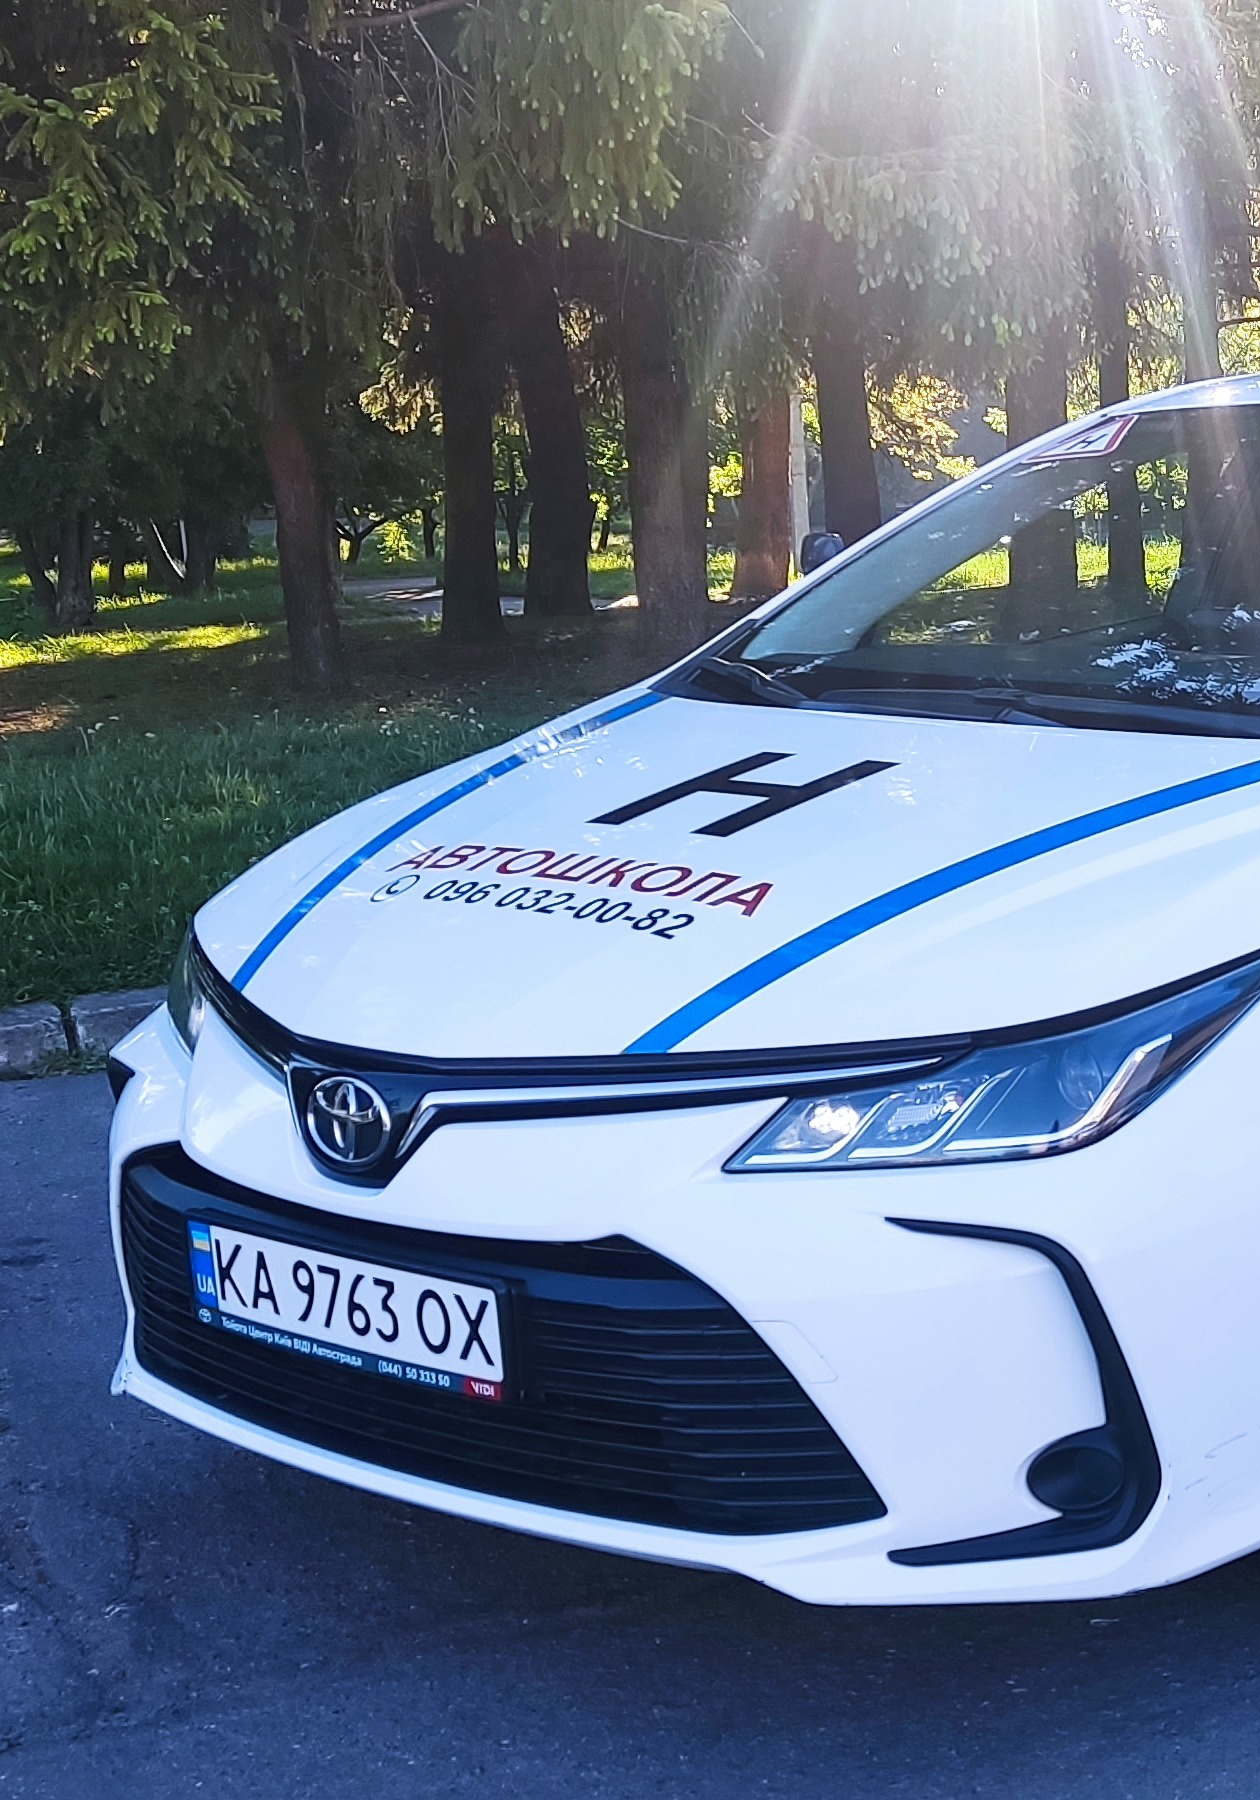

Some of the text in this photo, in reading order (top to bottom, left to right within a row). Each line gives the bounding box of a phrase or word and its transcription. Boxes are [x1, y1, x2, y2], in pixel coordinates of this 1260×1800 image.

[386, 844, 774, 917] АВТОШКОЛА
[423, 878, 695, 939] 096 032-00-82
[197, 1273, 216, 1297] UA
[292, 1259, 400, 1343] 9763
